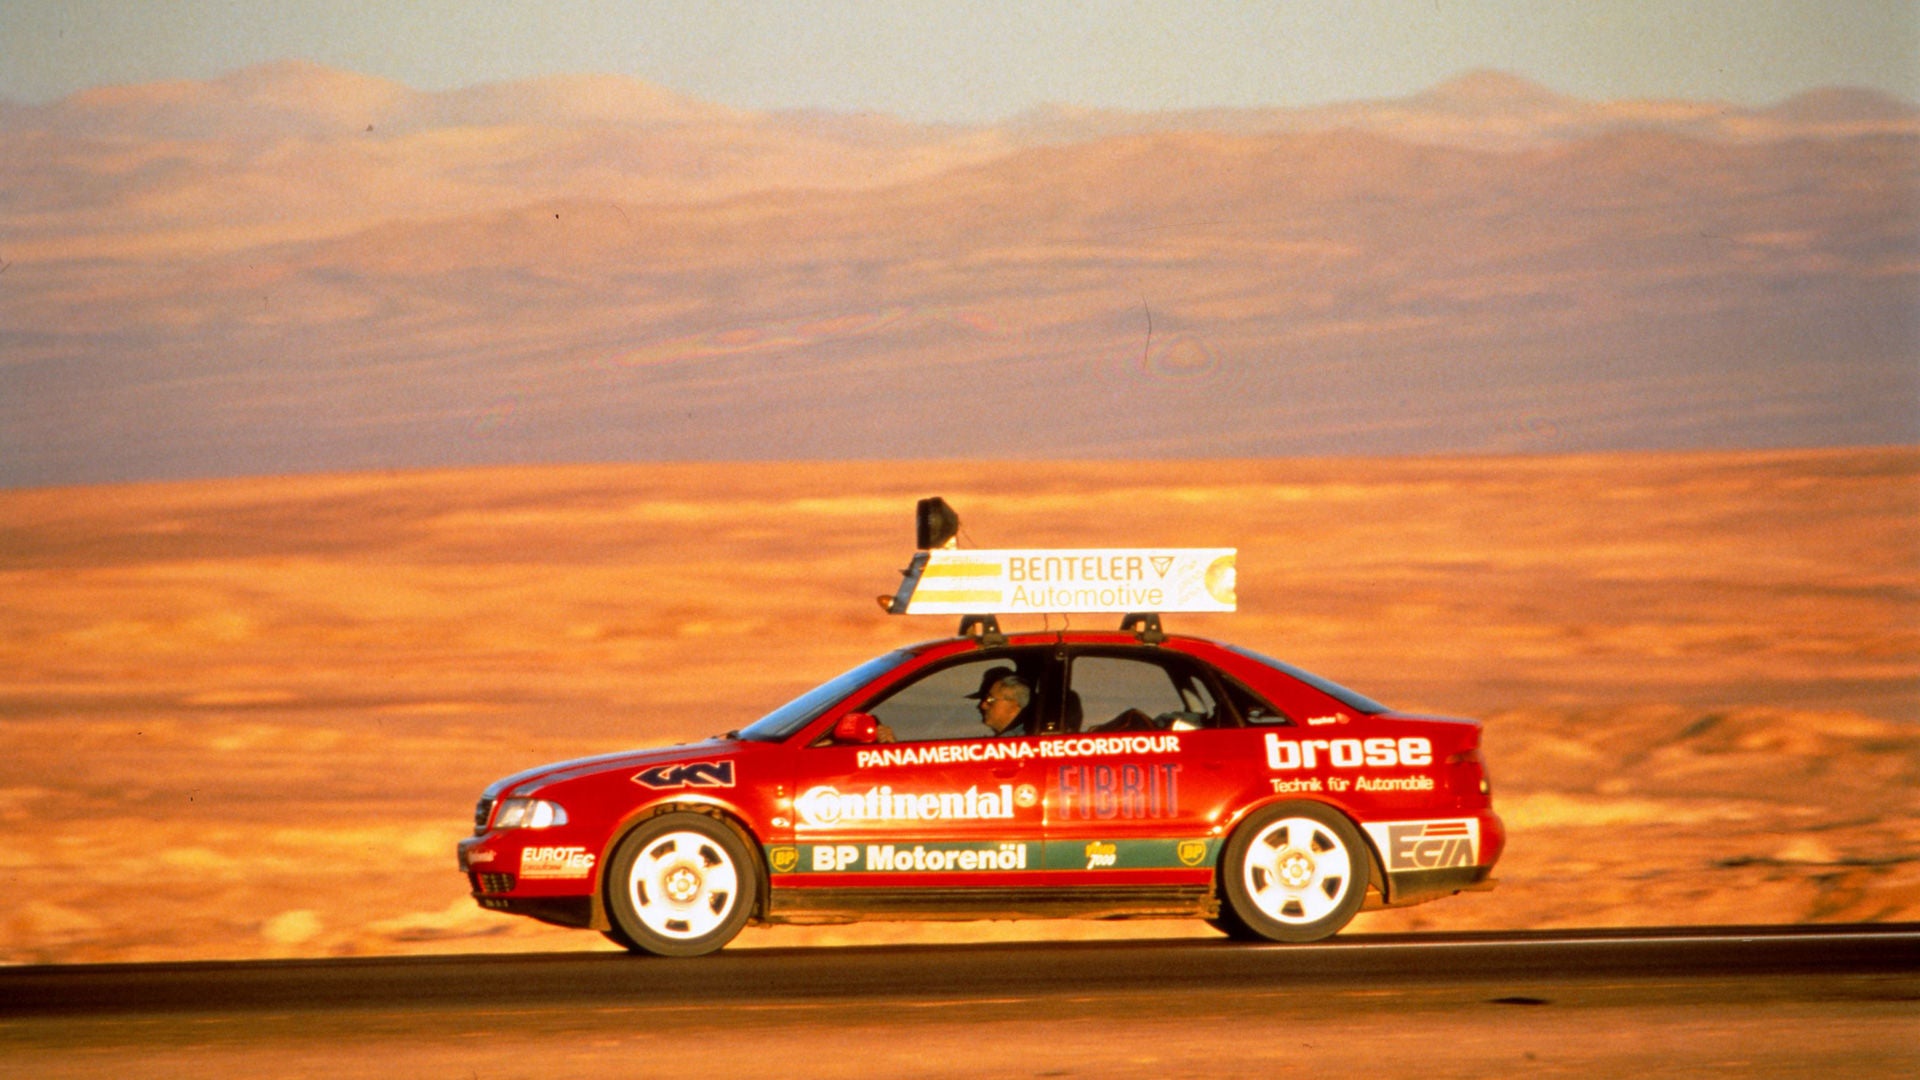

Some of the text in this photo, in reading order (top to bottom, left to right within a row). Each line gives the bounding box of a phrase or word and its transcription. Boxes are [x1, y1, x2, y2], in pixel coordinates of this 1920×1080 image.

[1009, 556, 1143, 582] BENTELER
[1010, 584, 1164, 608] Automotive
[857, 736, 1180, 768] PANAMERICANA-RECORDTOUR
[1265, 733, 1432, 769] brose
[1058, 763, 1182, 820] FIBRIT
[1270, 775, 1434, 793] Technik für Automobile
[797, 784, 1014, 828] Continental
[812, 843, 1027, 871] BP Motorenöl
